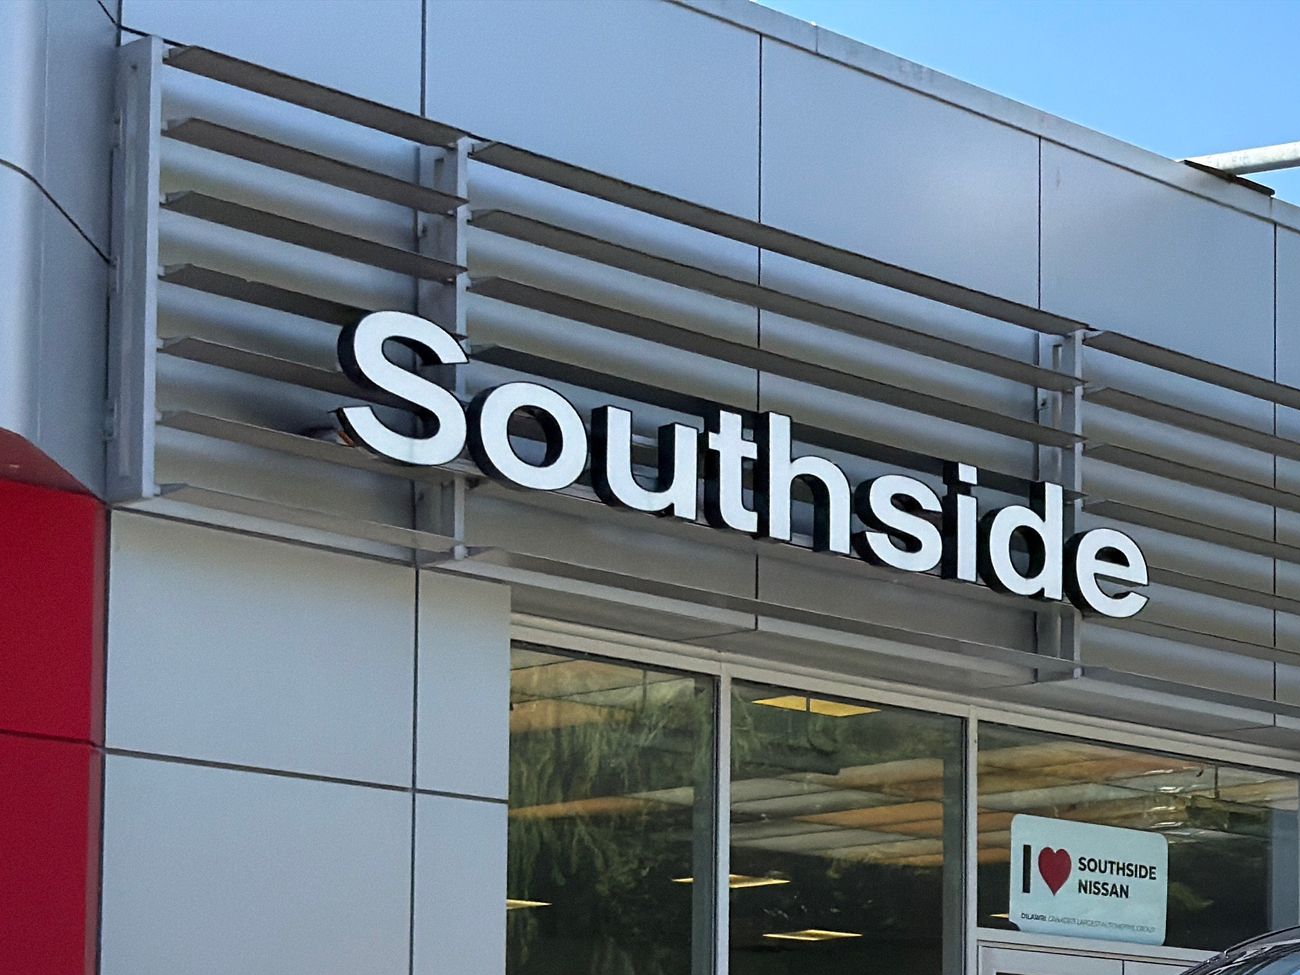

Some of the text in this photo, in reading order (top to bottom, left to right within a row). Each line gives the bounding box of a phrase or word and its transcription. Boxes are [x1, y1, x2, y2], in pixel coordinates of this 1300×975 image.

[337, 309, 1151, 619] Southside
[1022, 844, 1032, 894] I
[1077, 856, 1157, 880] SOUTHSIDE
[1077, 879, 1130, 898] NISSAN
